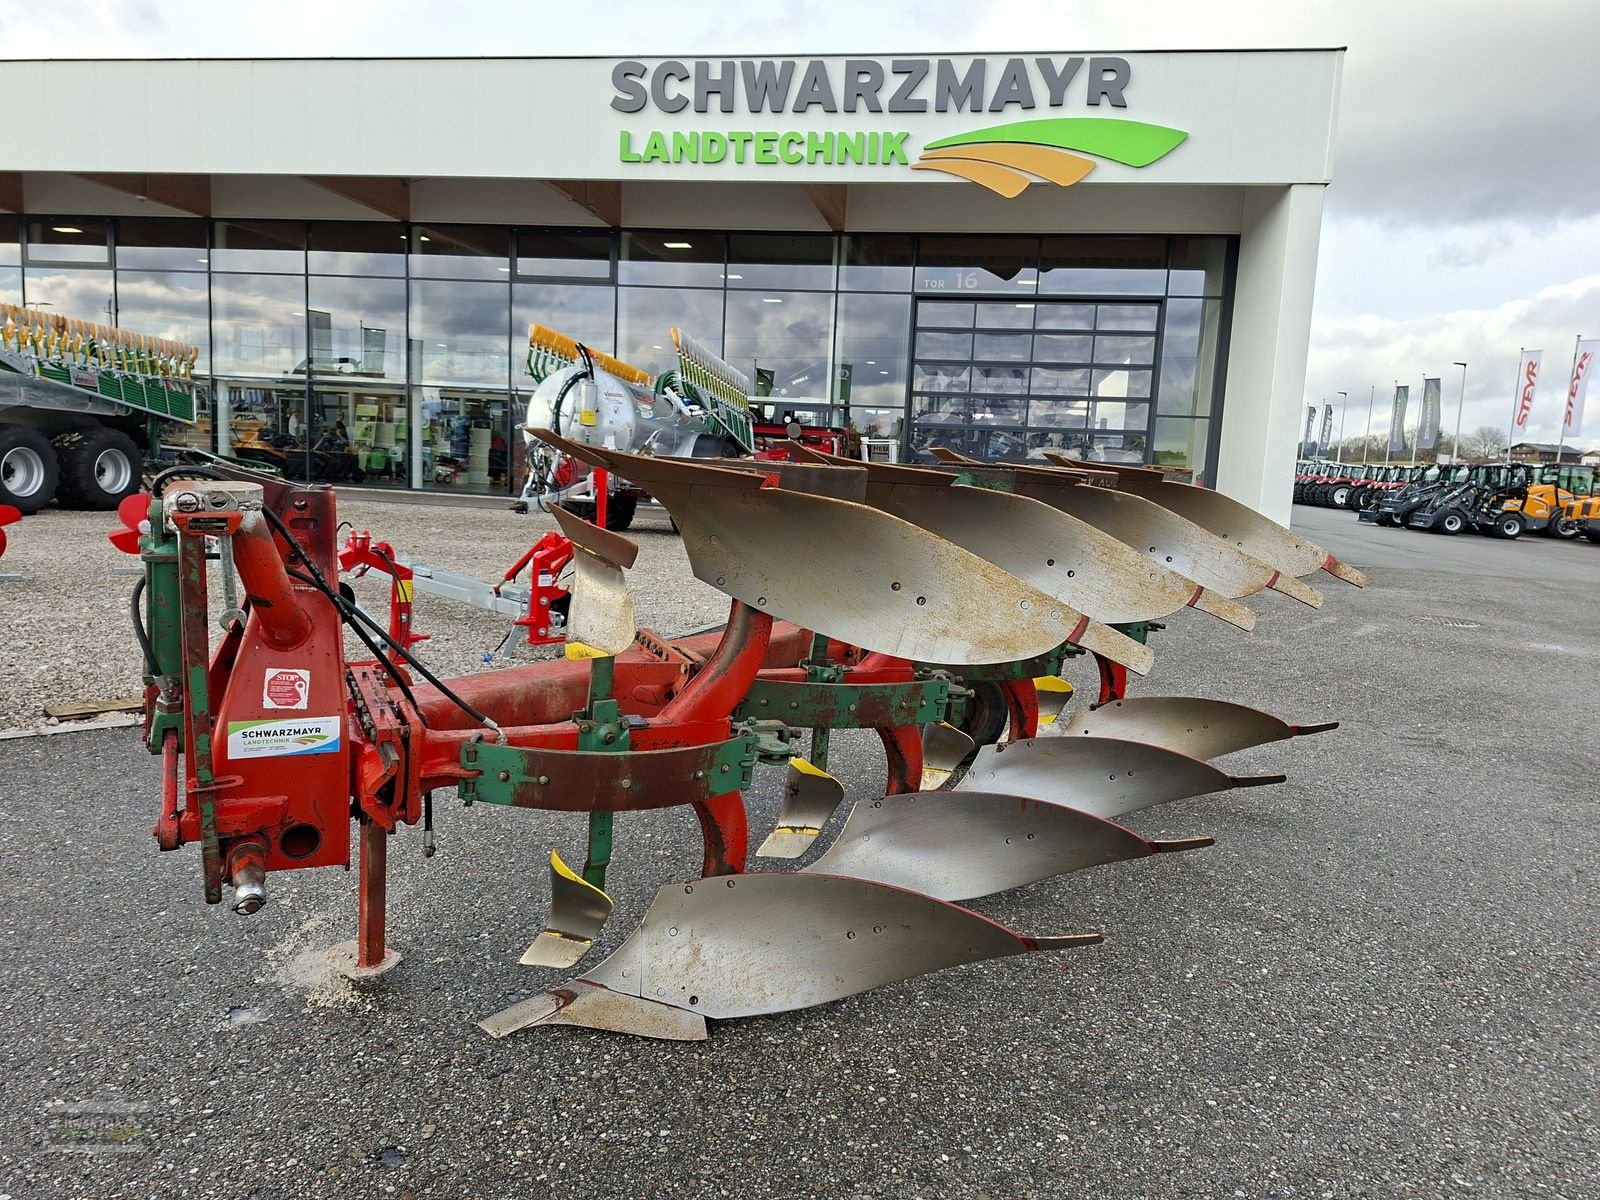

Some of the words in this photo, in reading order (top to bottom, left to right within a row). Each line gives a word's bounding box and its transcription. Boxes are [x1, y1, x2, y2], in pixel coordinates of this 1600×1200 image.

[610, 57, 1132, 113] SCHWARZMAYR
[619, 130, 910, 166] LANDTECHNIK
[924, 280, 945, 289] TOR
[956, 272, 978, 289] 16
[1517, 361, 1537, 426] STEYR
[242, 727, 321, 738] SCHWARZMAYR
[243, 738, 290, 746] LANDTECHNIK
